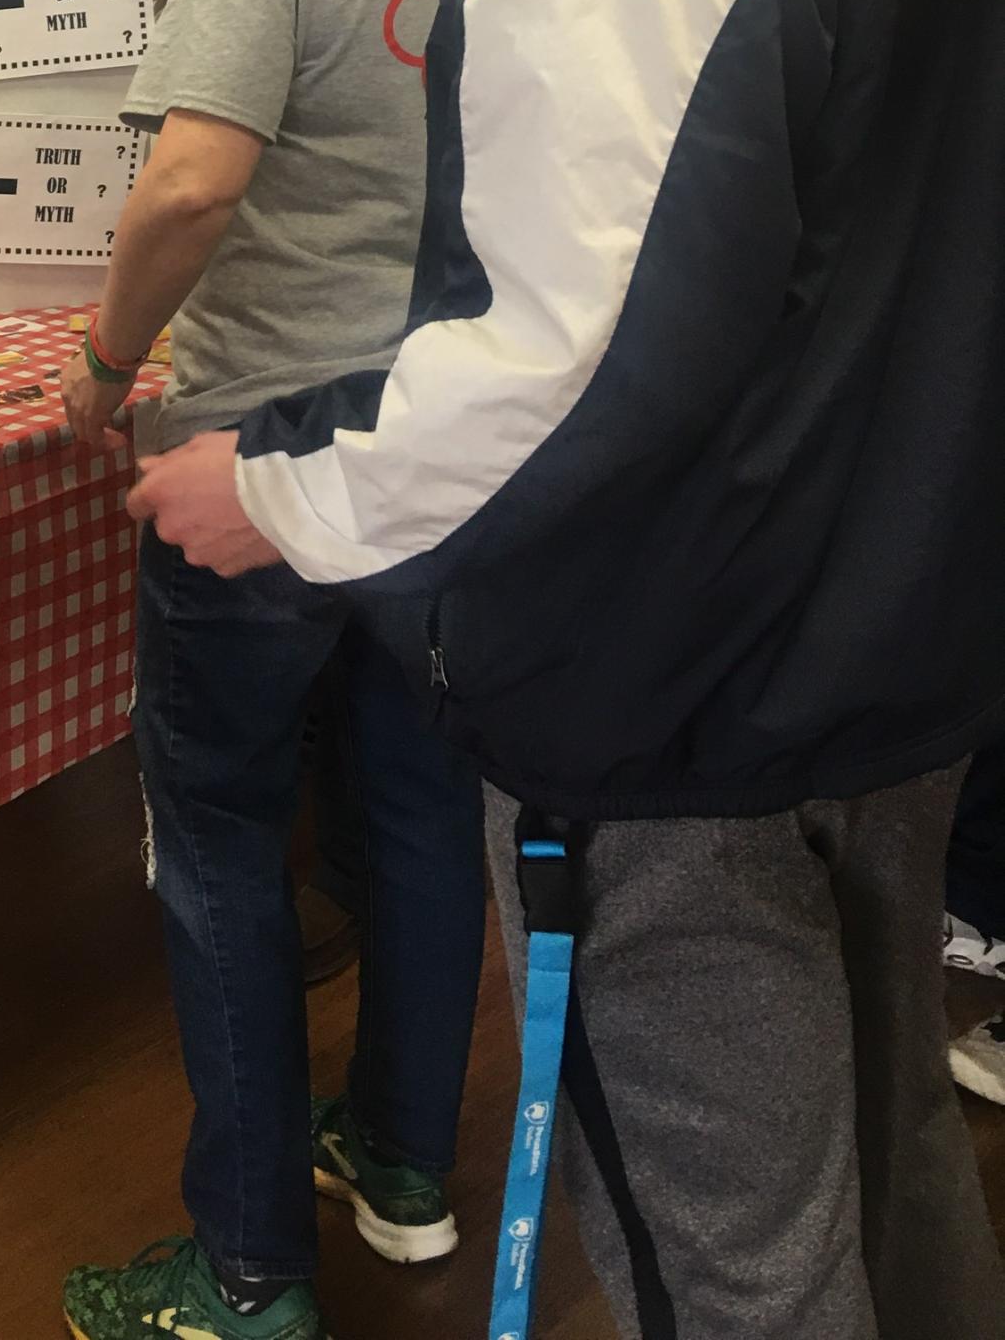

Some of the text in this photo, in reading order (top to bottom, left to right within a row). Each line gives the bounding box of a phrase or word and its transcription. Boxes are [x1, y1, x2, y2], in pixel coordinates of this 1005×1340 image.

[46, 12, 87, 32] MYTH
[35, 147, 82, 166] TRUTH
[47, 177, 68, 194] OR
[35, 205, 74, 223] MYTH
